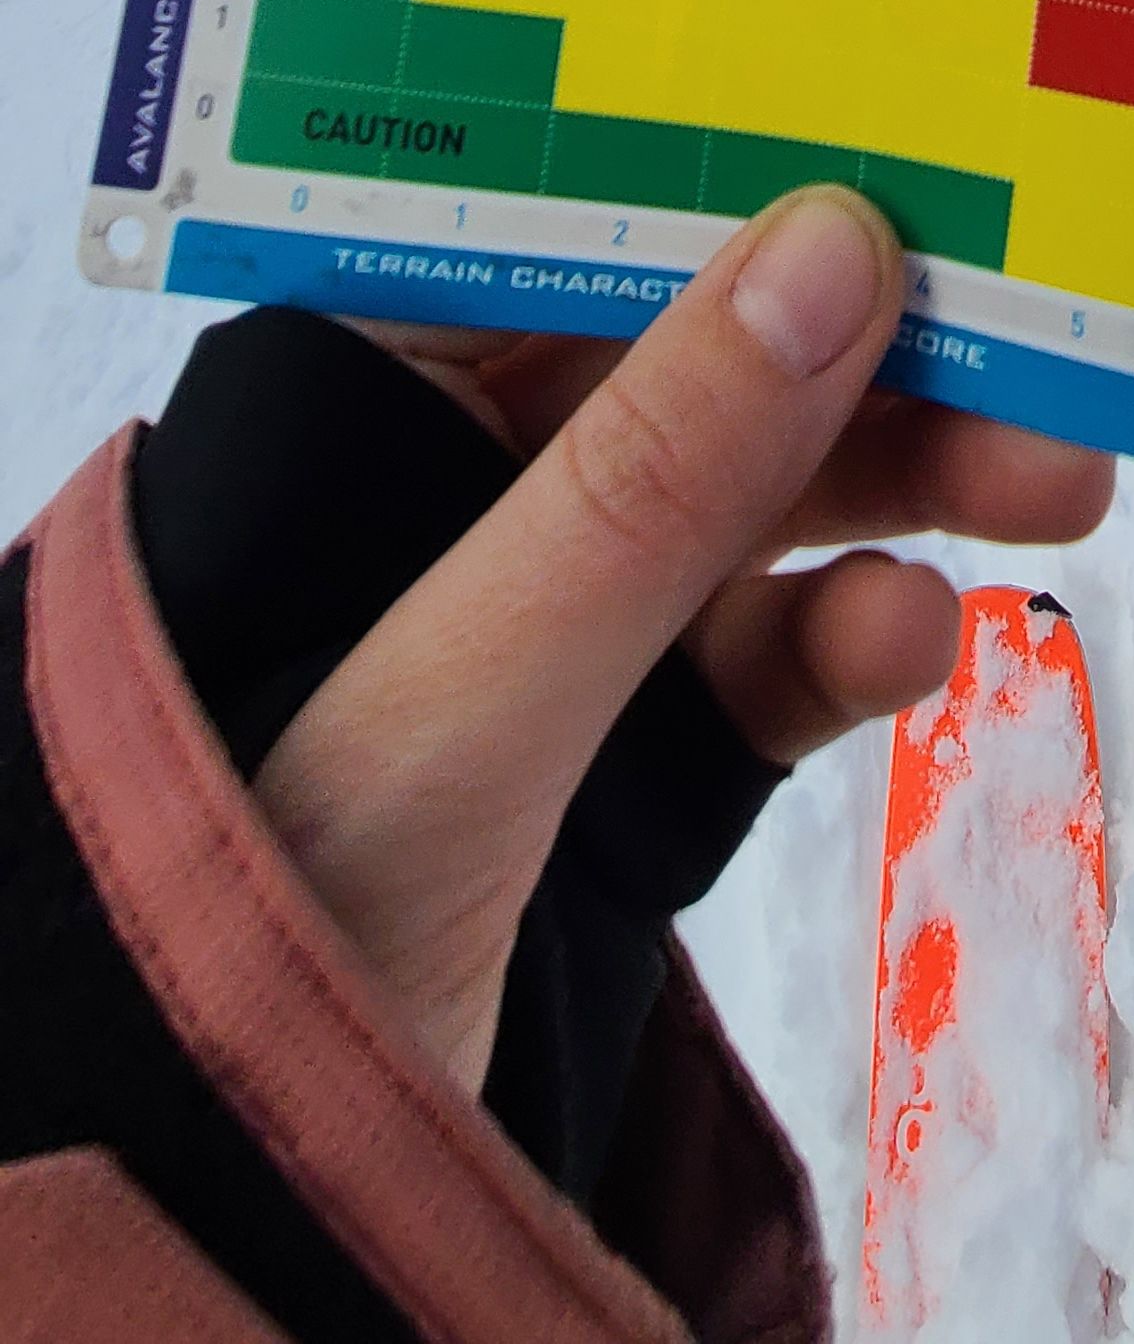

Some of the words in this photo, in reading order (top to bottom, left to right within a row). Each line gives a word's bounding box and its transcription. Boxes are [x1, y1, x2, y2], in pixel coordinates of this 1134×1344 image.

[217, 4, 229, 29] 1
[196, 93, 215, 121] 0
[303, 108, 468, 157] CAUTION
[290, 184, 310, 214] 0
[455, 201, 468, 231] 1
[611, 218, 631, 247] 2
[335, 246, 495, 287] TERRAIN
[510, 265, 688, 304] CHARACT
[898, 324, 987, 371] CORE
[1071, 310, 1086, 340] 5
